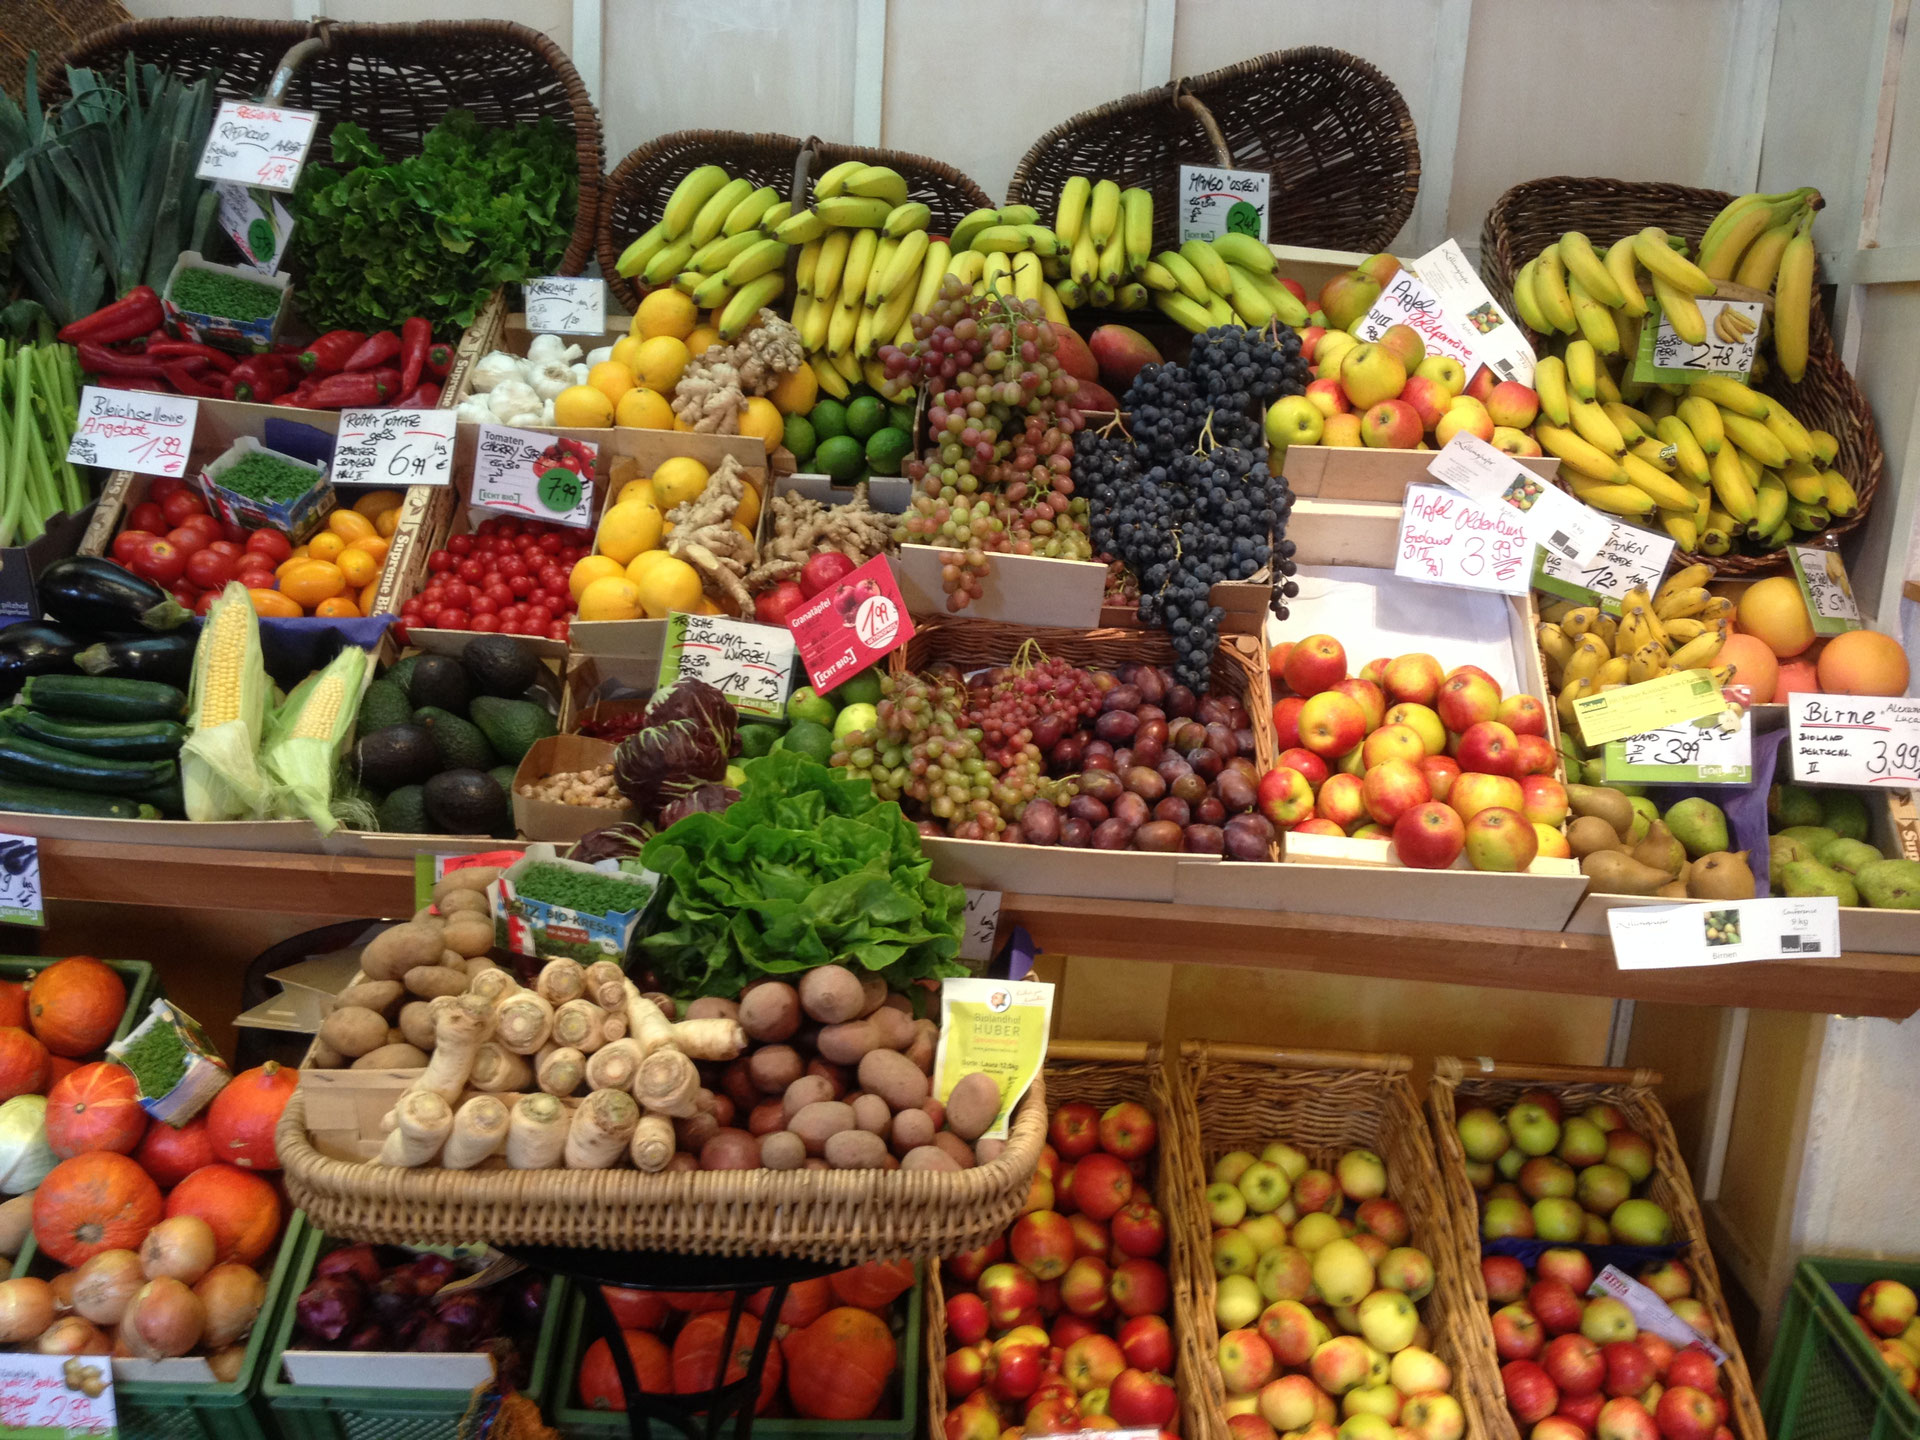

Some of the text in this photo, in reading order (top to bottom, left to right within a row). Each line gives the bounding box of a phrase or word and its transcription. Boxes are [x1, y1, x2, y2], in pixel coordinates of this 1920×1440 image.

[1682, 343, 1735, 369] 2.78
[442, 360, 469, 407] Supreme
[80, 417, 150, 438] Angebot
[484, 430, 525, 446] Tomaten
[547, 477, 578, 506] 7.99
[1411, 494, 1454, 522] Apfel
[1455, 507, 1529, 548] Oldenburg
[379, 534, 410, 595] Supreme
[792, 597, 832, 628] Granatäpfel
[861, 600, 889, 637] 1.99
[723, 648, 777, 667] WURZEL
[712, 671, 750, 693] 1.98
[1802, 701, 1876, 725] Birne
[1799, 732, 1844, 741] BIOLAND
[546, 908, 619, 937] BIO-KRESSE
[604, 941, 617, 949] BIO
[1712, 950, 1738, 960] Birnen
[974, 1012, 1022, 1024] Biolandhof
[974, 1023, 1021, 1037] HUBER
